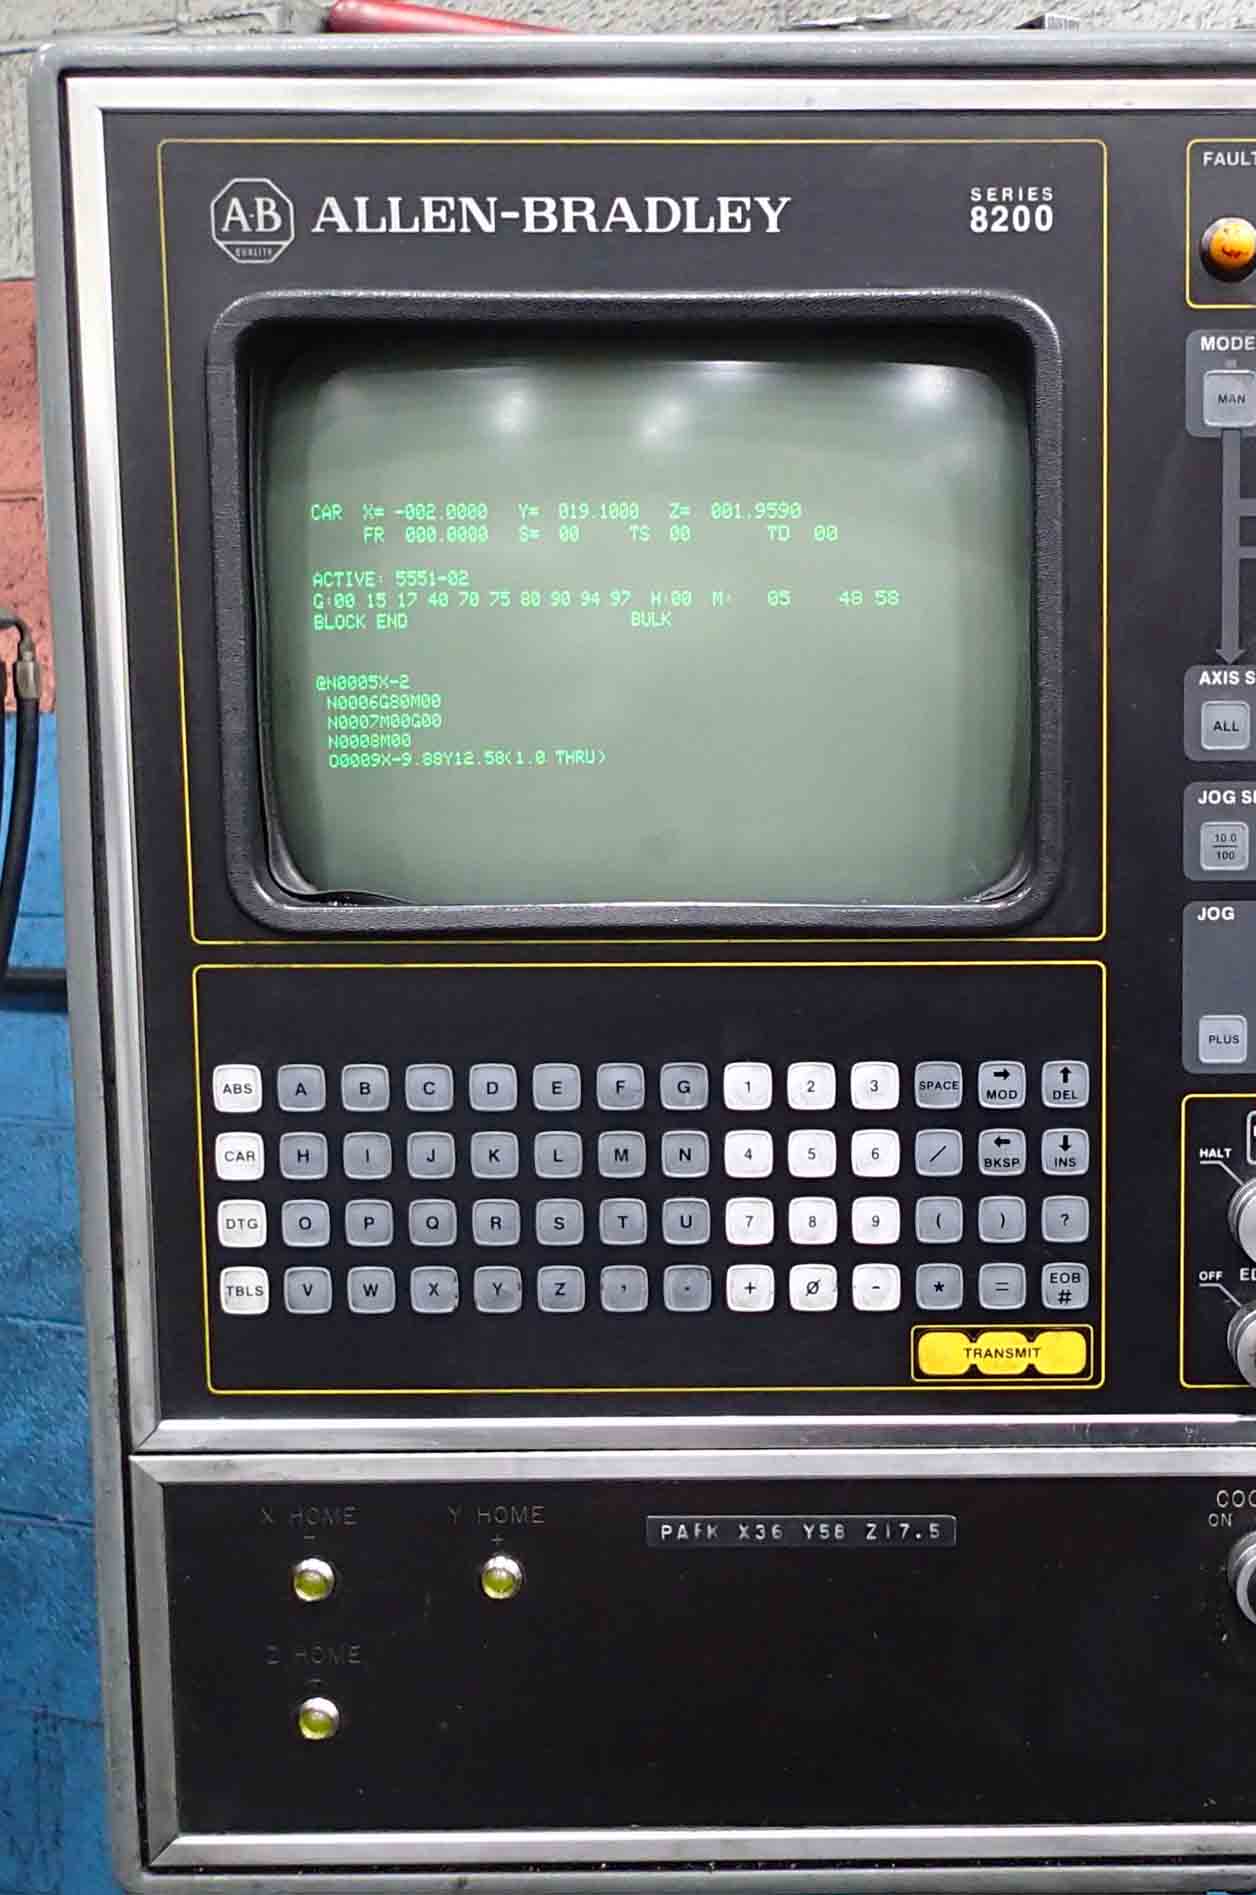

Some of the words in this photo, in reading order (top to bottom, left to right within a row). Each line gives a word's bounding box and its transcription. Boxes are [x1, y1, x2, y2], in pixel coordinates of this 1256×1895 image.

[970, 187, 1055, 201] SERIES
[312, 194, 792, 235] ALLEN-BRADLEY
[969, 204, 1055, 234] 8200
[1200, 336, 1256, 351] MODE
[1217, 393, 1246, 405] MAN
[311, 503, 344, 521] CAR
[394, 503, 488, 521] -002.0000
[559, 502, 640, 520] 019.1000
[711, 502, 802, 520] 001.9590
[364, 526, 385, 544] FR
[559, 525, 580, 543] 00
[629, 525, 651, 542] TS
[669, 525, 691, 542] 00
[814, 525, 839, 542] 00
[395, 570, 470, 587] 5551-02
[490, 591, 511, 608] 75
[581, 590, 601, 607] 94
[609, 590, 632, 607] 97
[767, 590, 791, 607] 05
[313, 614, 367, 631] BLOCK
[376, 613, 408, 630] END
[631, 611, 672, 627] BULK
[1199, 670, 1240, 685] AXIS
[1213, 720, 1239, 732] ALL
[1198, 790, 1235, 805] JOG
[1198, 906, 1235, 921] JOG
[1208, 1035, 1240, 1045] PLUS
[222, 1083, 253, 1095] ABS
[423, 1082, 436, 1096] C
[919, 1080, 960, 1091] SPACE
[985, 1089, 1018, 1101] MOD
[1052, 1089, 1079, 1101] DEL
[224, 1151, 256, 1162] CAR
[297, 1149, 310, 1163] H
[614, 1149, 629, 1162] M
[1199, 1148, 1233, 1159] HALT
[983, 1157, 1020, 1168] BKSP
[1054, 1157, 1076, 1168] INS
[225, 1218, 258, 1230] DTG
[491, 1216, 502, 1230] R
[1049, 1273, 1081, 1284] EOB
[1199, 1270, 1223, 1281] OFF
[226, 1285, 264, 1297] TBLS
[362, 1283, 378, 1297] W
[963, 1347, 1041, 1359] TRANSMIT
[290, 1506, 358, 1526] HOME
[477, 1505, 545, 1525] HOME
[1208, 1513, 1233, 1527] ON
[738, 1524, 783, 1540] X36
[295, 1645, 361, 1664] HOME
